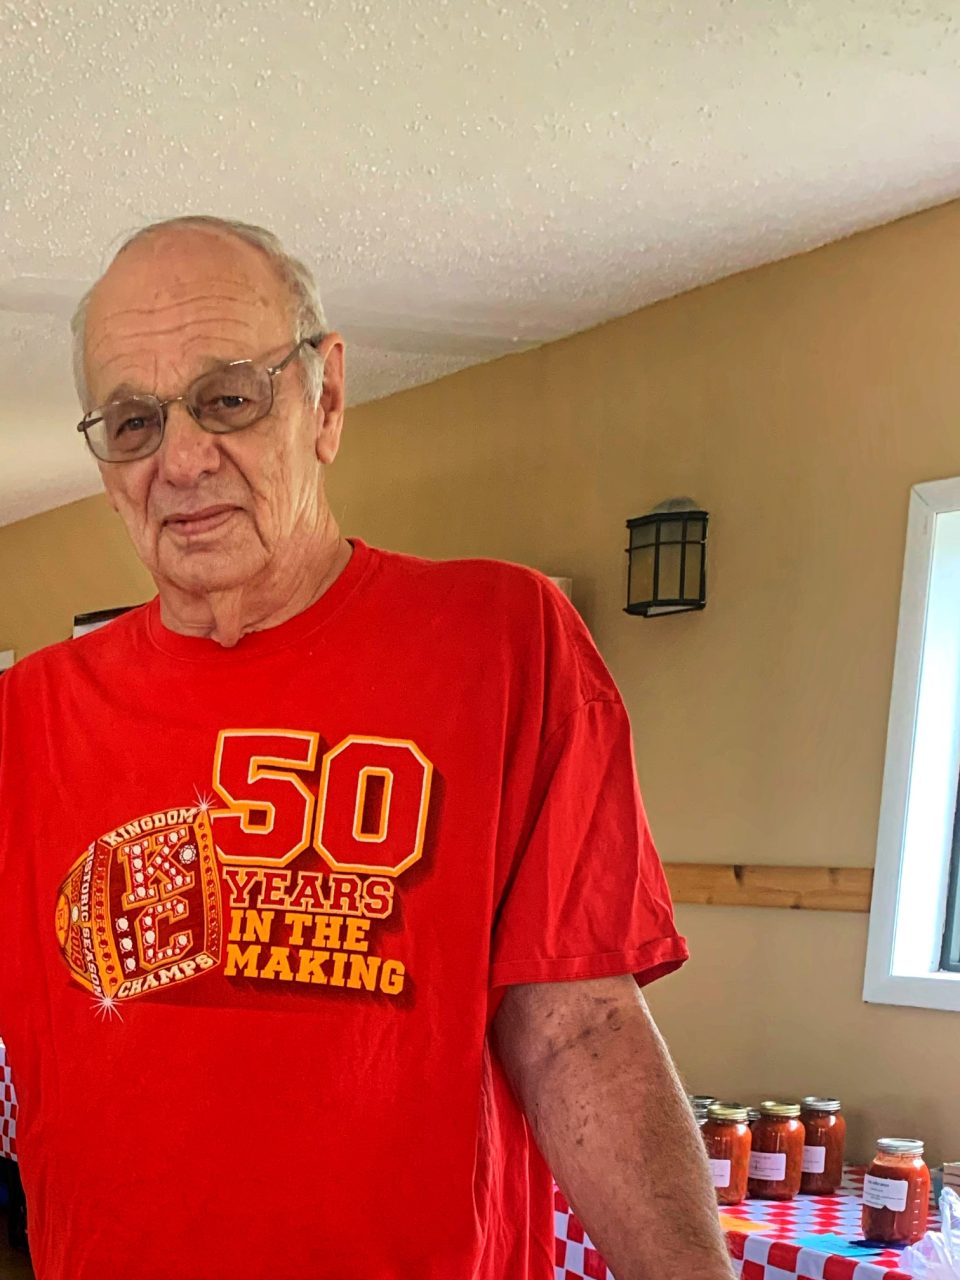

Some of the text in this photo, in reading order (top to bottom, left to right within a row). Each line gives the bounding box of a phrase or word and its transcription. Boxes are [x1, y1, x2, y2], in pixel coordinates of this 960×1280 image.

[210, 729, 433, 877] 50
[101, 808, 198, 848] KINGDOM
[222, 867, 394, 919] YEARS
[228, 910, 370, 952] IN THE
[117, 954, 214, 998] CHAMPS
[224, 944, 405, 995] MAKING
